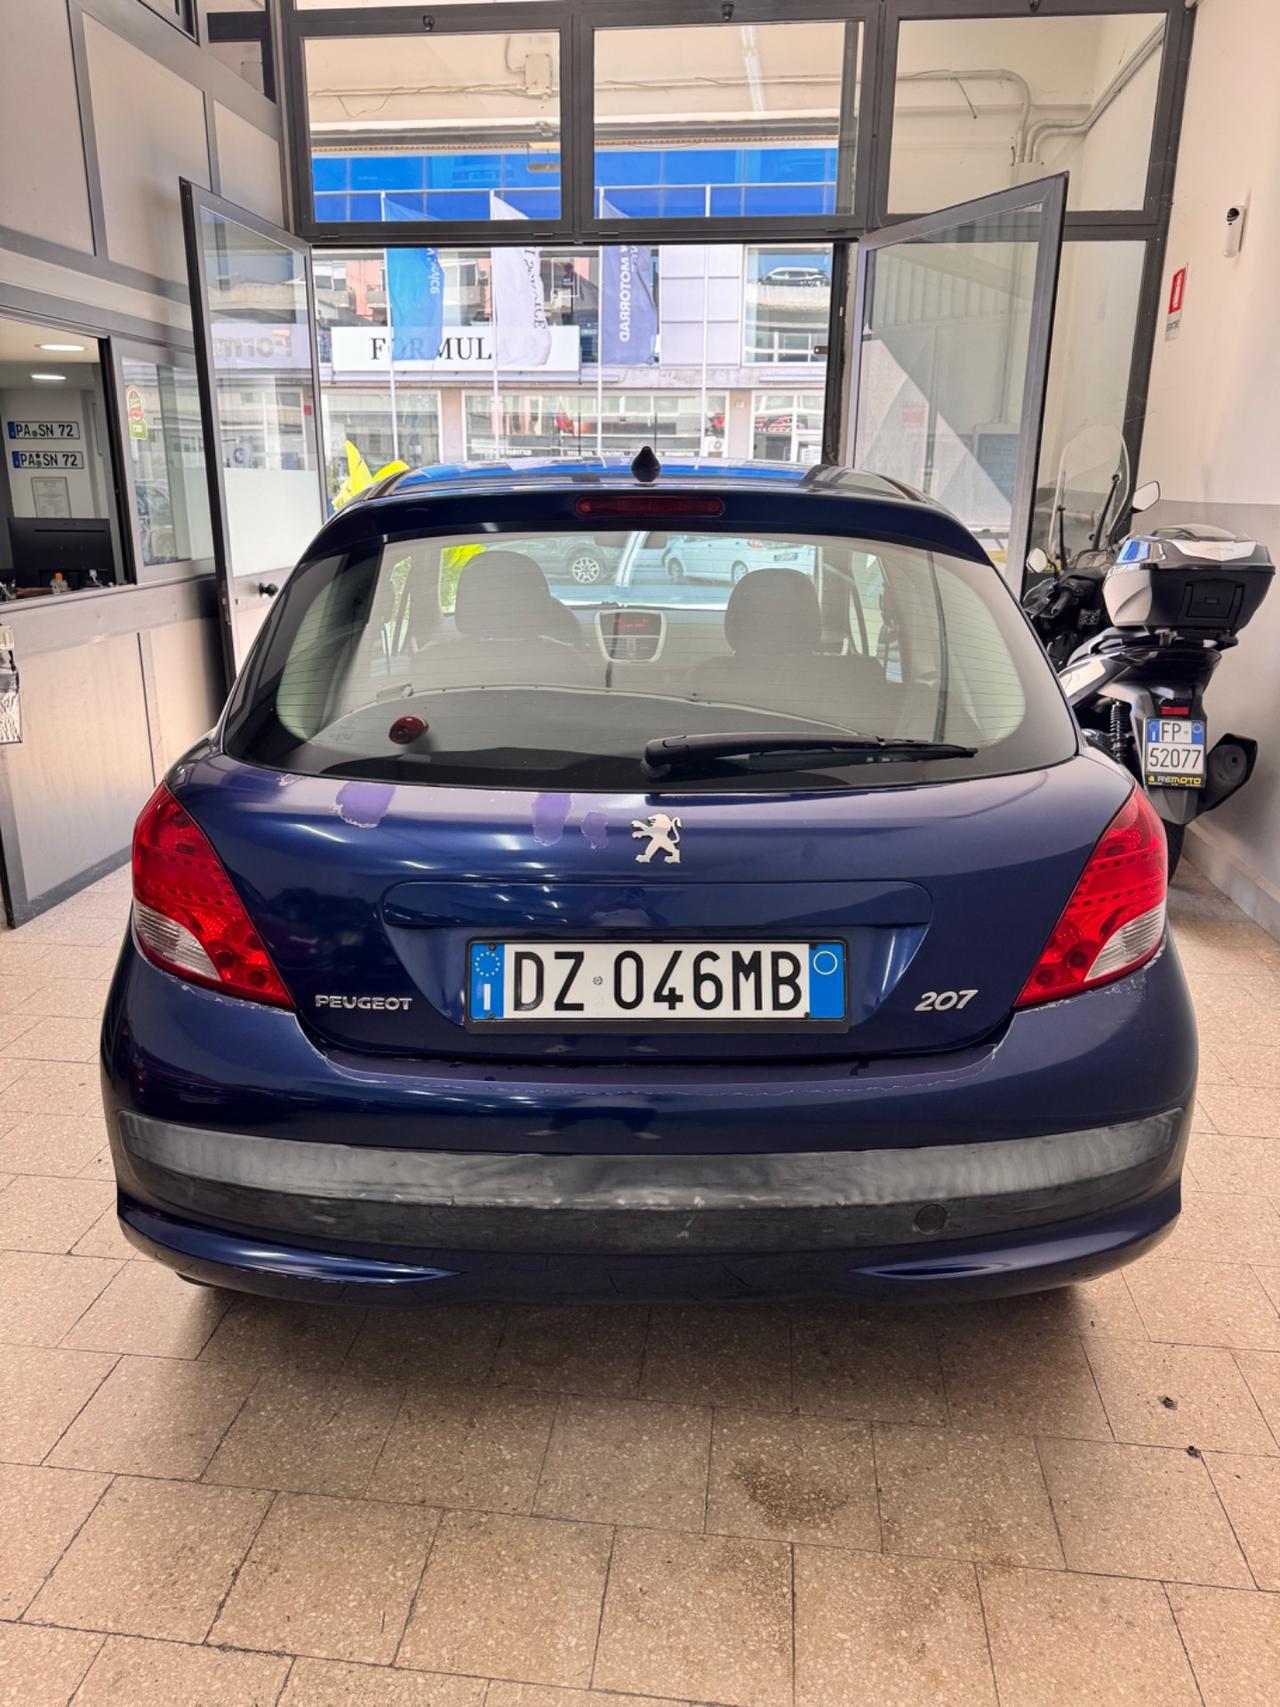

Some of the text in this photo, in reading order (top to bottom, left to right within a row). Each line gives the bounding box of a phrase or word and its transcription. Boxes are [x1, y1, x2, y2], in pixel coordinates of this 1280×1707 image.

[59, 424, 74, 437] 72
[62, 453, 78, 466] 72
[1161, 722, 1182, 741] FP
[1149, 748, 1201, 769] 52077
[315, 994, 413, 1011] PEUGEOT
[914, 989, 979, 1012] 207
